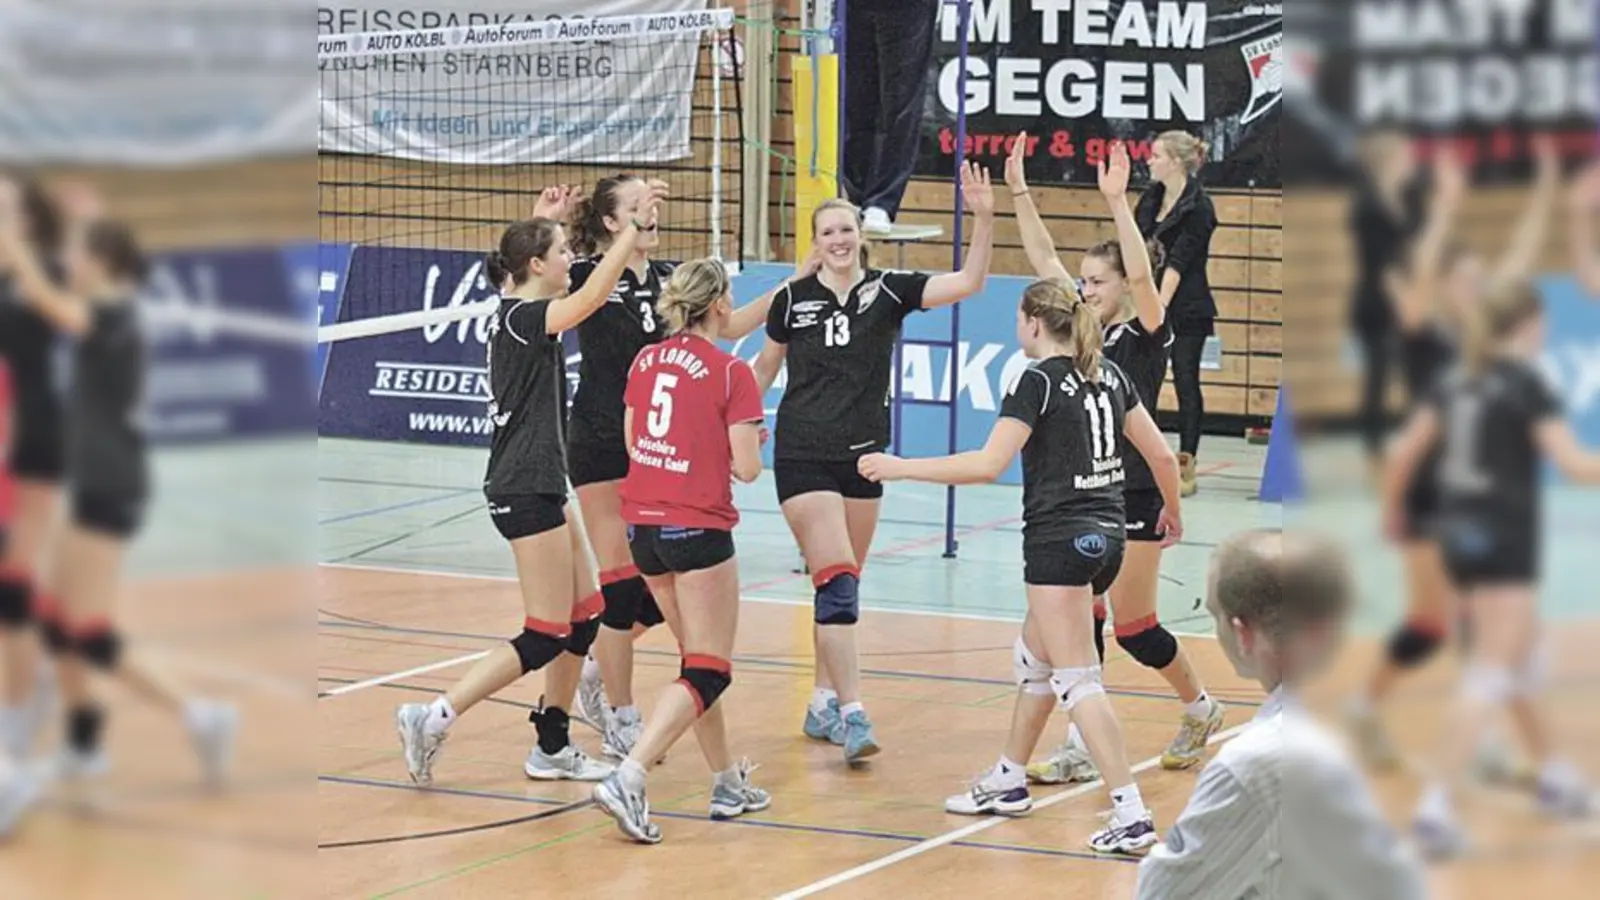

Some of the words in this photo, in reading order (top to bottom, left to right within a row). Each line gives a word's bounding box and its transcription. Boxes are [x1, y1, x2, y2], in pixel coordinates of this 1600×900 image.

[367, 34, 402, 50] AUTO
[464, 26, 543, 44] AutoForum
[558, 20, 631, 38] AutoForum
[1032, 0, 1206, 49] TEAM
[443, 52, 613, 78] STARNBERG
[938, 56, 1206, 122] GEGEN
[1048, 129, 1076, 158] &
[640, 301, 656, 333] 3
[823, 313, 850, 347] 13
[1060, 373, 1079, 397] SV
[647, 371, 679, 438] 5
[1084, 391, 1116, 459] 11
